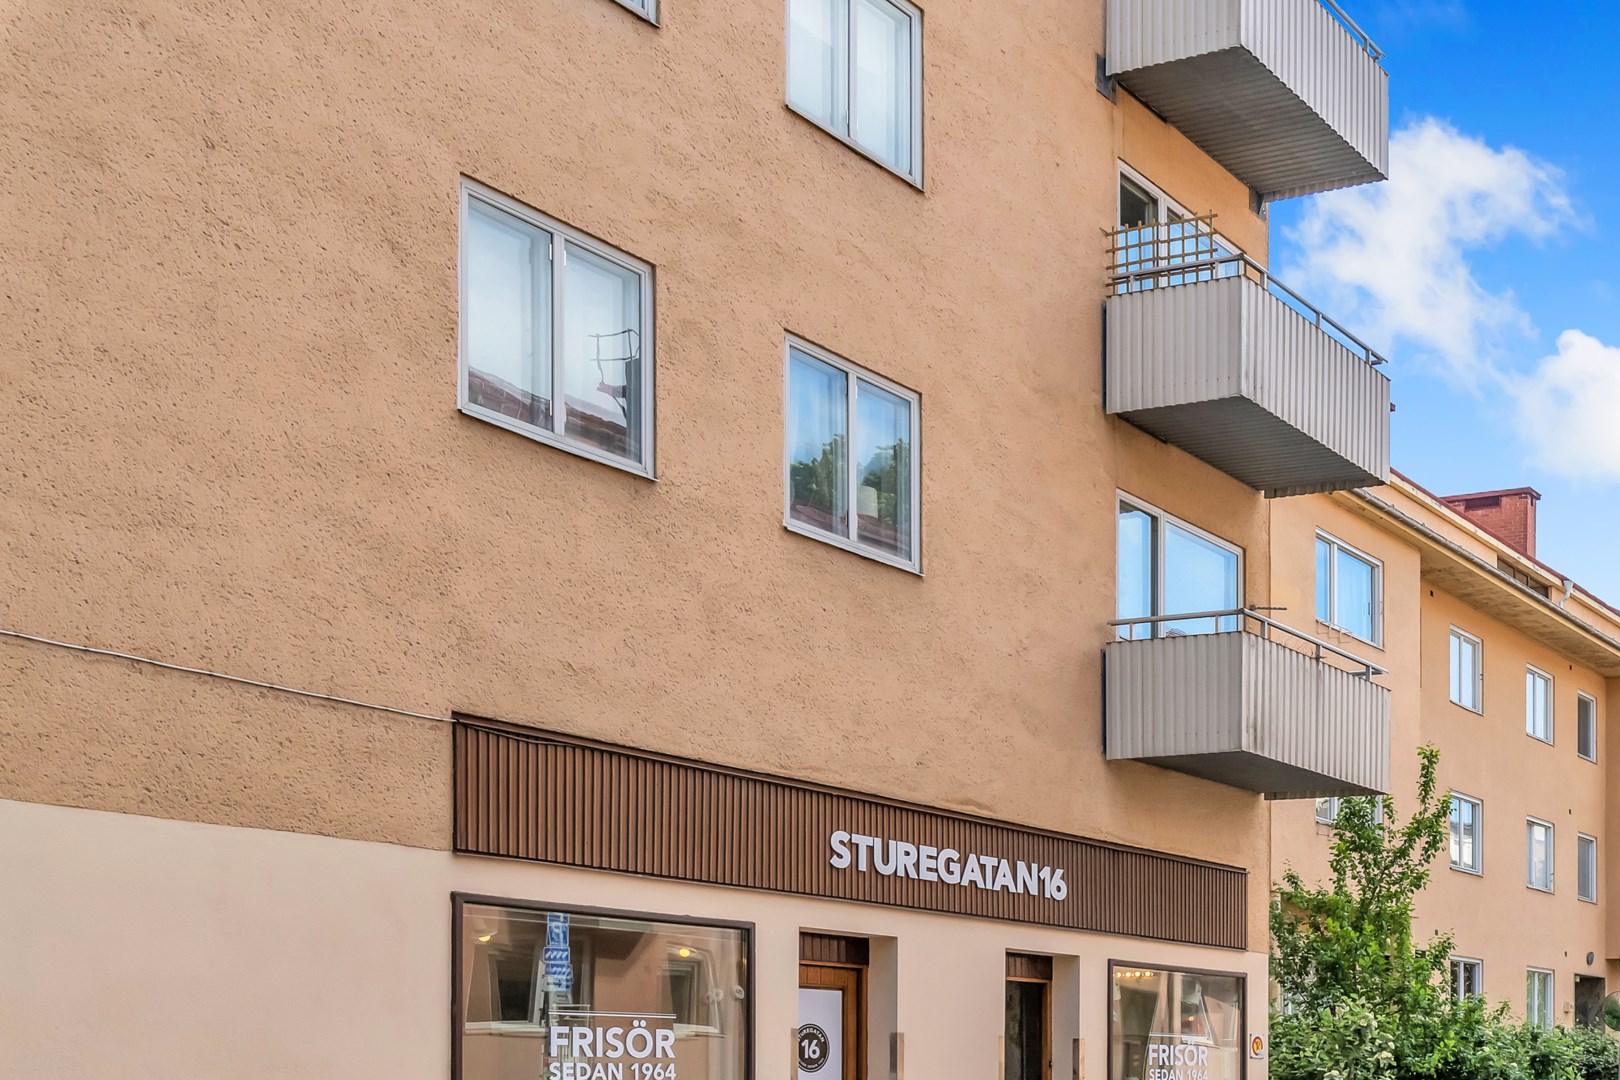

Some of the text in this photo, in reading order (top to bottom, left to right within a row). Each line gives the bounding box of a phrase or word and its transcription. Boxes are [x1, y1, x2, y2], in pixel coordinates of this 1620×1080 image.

[550, 1019, 676, 1059] FRISÖR
[801, 1039, 820, 1059] 16
[1148, 1040, 1208, 1067] FRISÖR
[549, 1062, 676, 1080] SEDAN 1964
